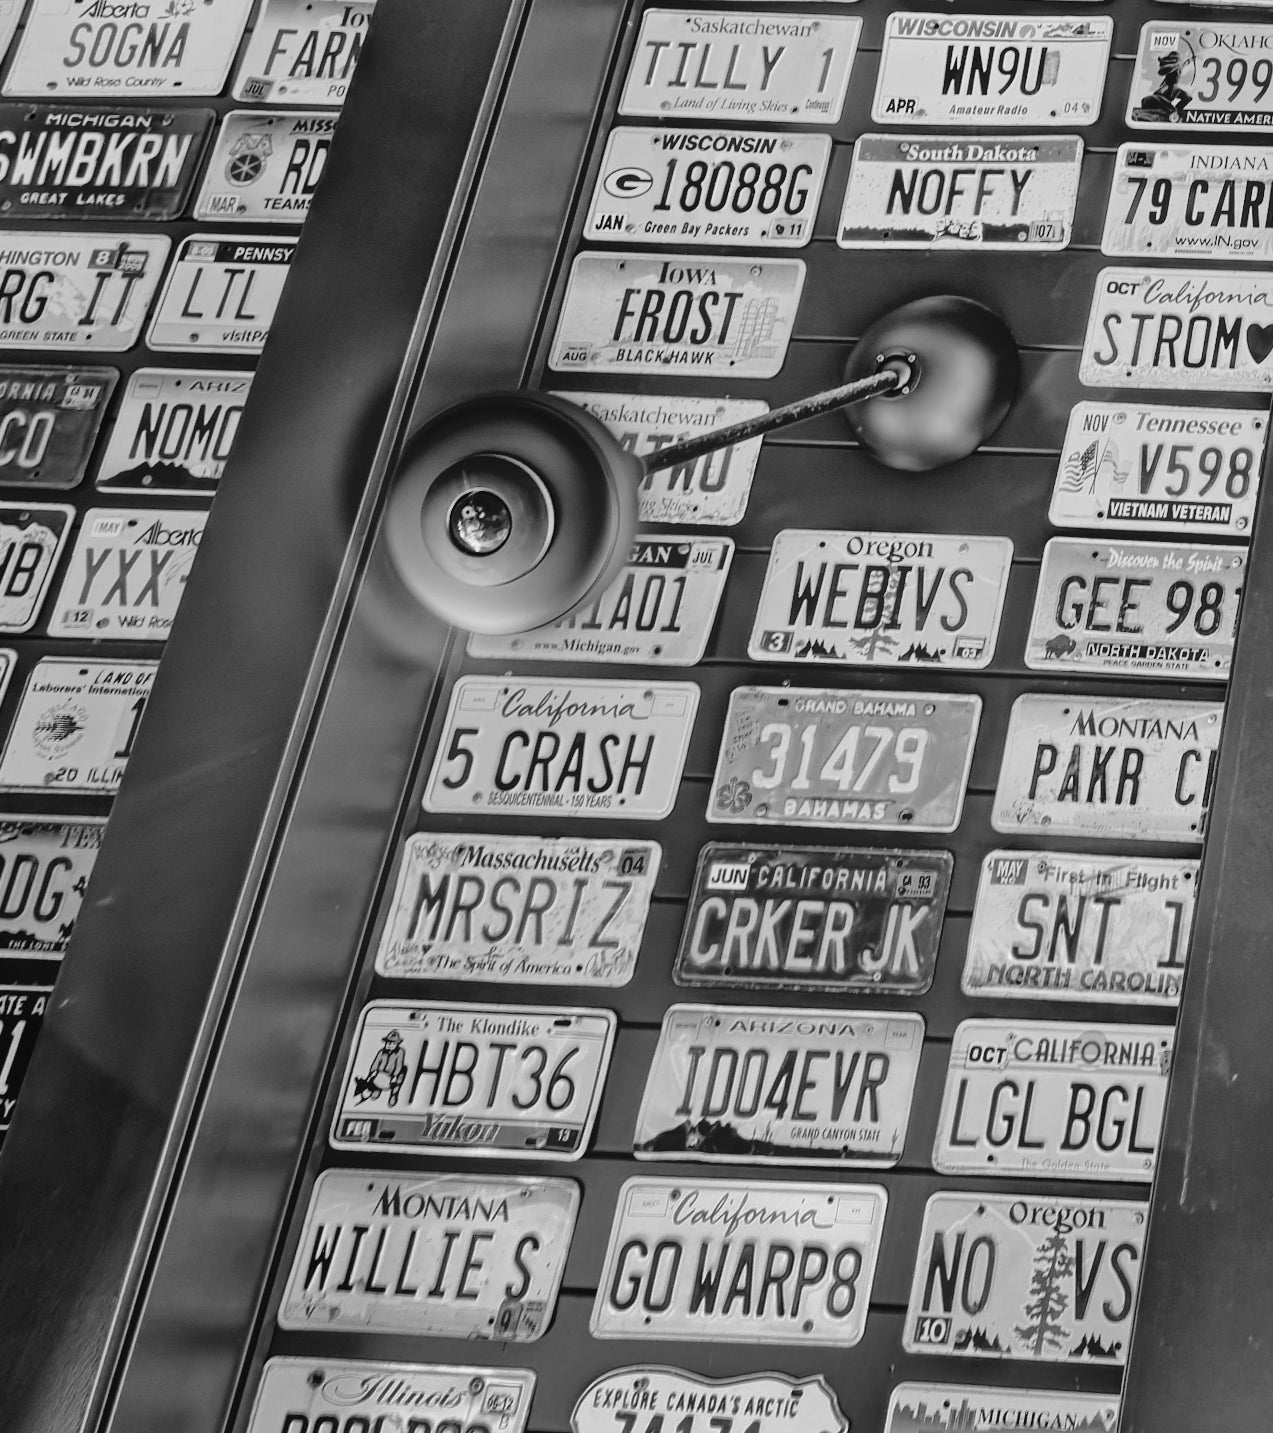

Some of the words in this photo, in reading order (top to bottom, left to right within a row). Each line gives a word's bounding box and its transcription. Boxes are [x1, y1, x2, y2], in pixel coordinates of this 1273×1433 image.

[63, 22, 191, 68] SOGNA
[897, 17, 1018, 38] WISCONSIN
[942, 45, 1049, 95] WN9U
[46, 114, 152, 126] MICHIGAN
[949, 103, 995, 115] Amateur
[997, 104, 1029, 116] Radio
[906, 144, 964, 162] South
[967, 145, 1037, 162] Dakota
[885, 168, 1034, 215] NOFFY
[645, 219, 680, 236] Green
[683, 221, 704, 237] Bay
[707, 221, 750, 236] Packers
[613, 289, 744, 346] FROST
[616, 347, 664, 363] BLACK
[668, 349, 714, 365] HAWK
[1109, 500, 1169, 520] VIETNAM
[1173, 502, 1230, 523] VETERAN
[788, 566, 974, 633] WEBIVS
[752, 724, 929, 793] 31479
[756, 866, 888, 894] CALIFORNIA
[692, 902, 847, 967] CRKER
[863, 903, 928, 973] JK
[409, 1043, 576, 1111] HBT36
[951, 1081, 1046, 1149] LGL
[608, 1240, 684, 1312] GO
[689, 1244, 863, 1320] WARP8
